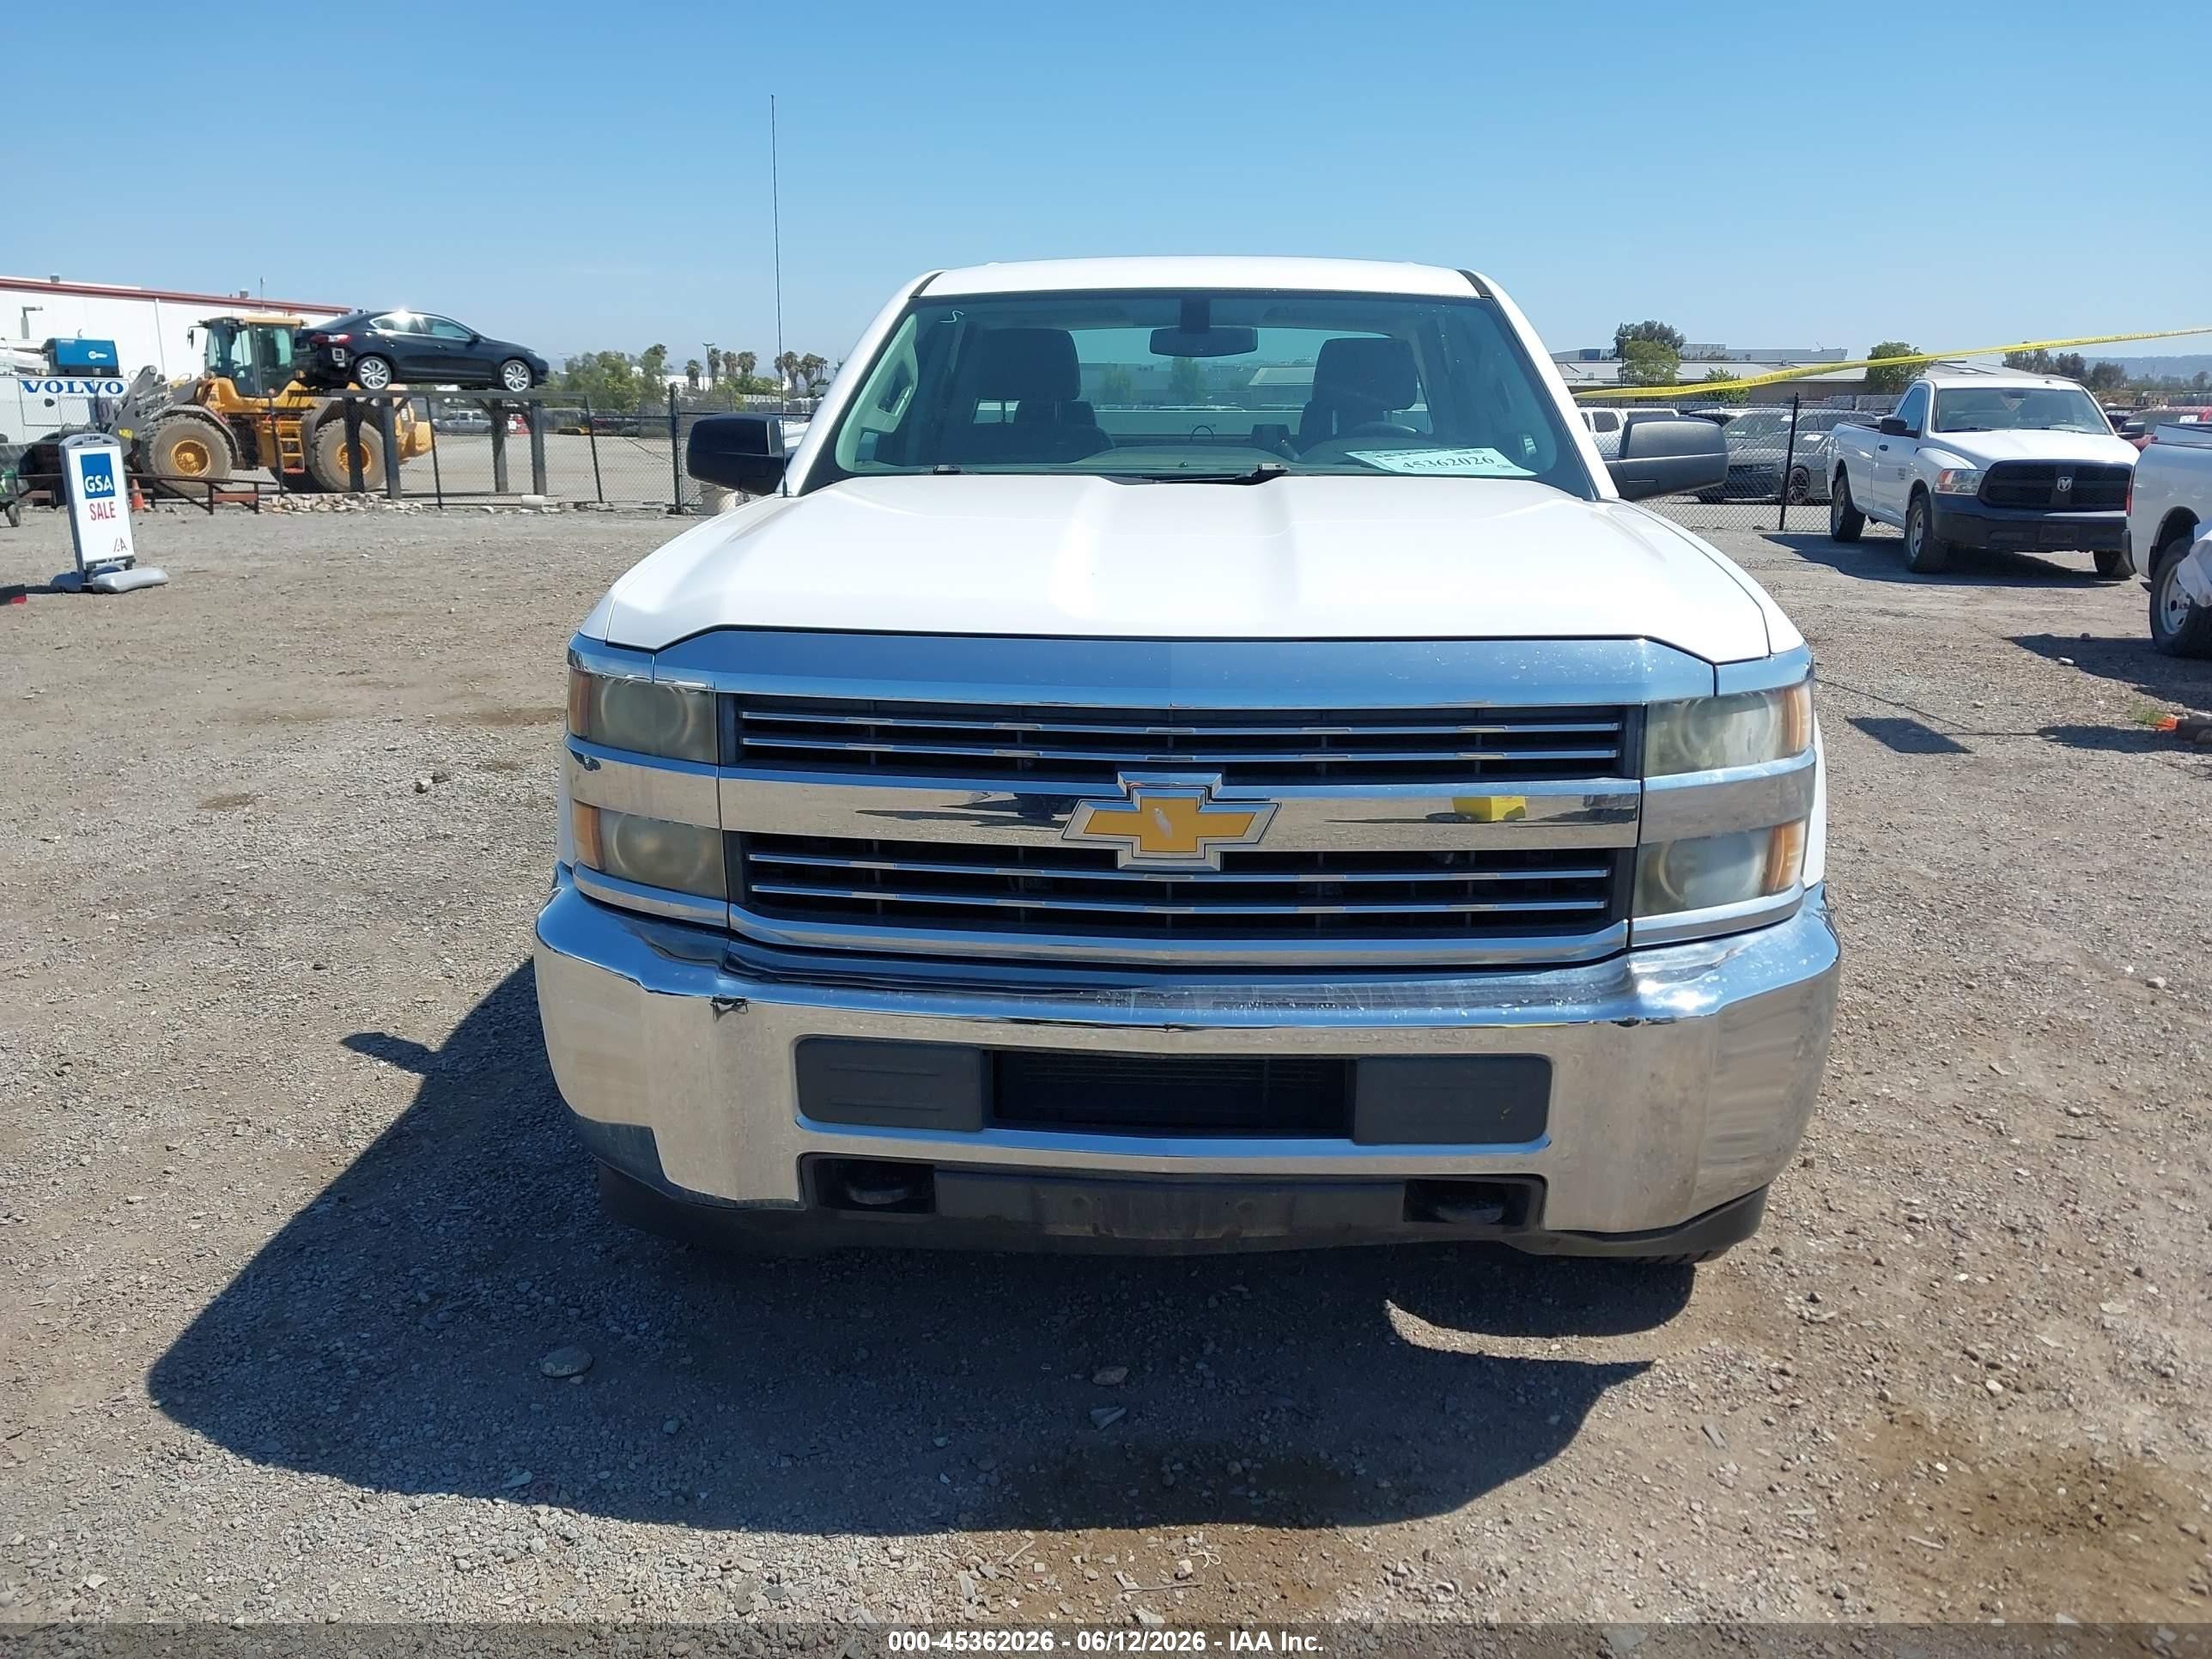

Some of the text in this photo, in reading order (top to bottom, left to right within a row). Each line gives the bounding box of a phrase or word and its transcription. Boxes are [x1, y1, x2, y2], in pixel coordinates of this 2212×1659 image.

[19, 380, 125, 394] VOLVO
[1402, 455, 1495, 469] 45362026
[85, 475, 113, 493] GSA
[89, 501, 116, 521] SALE
